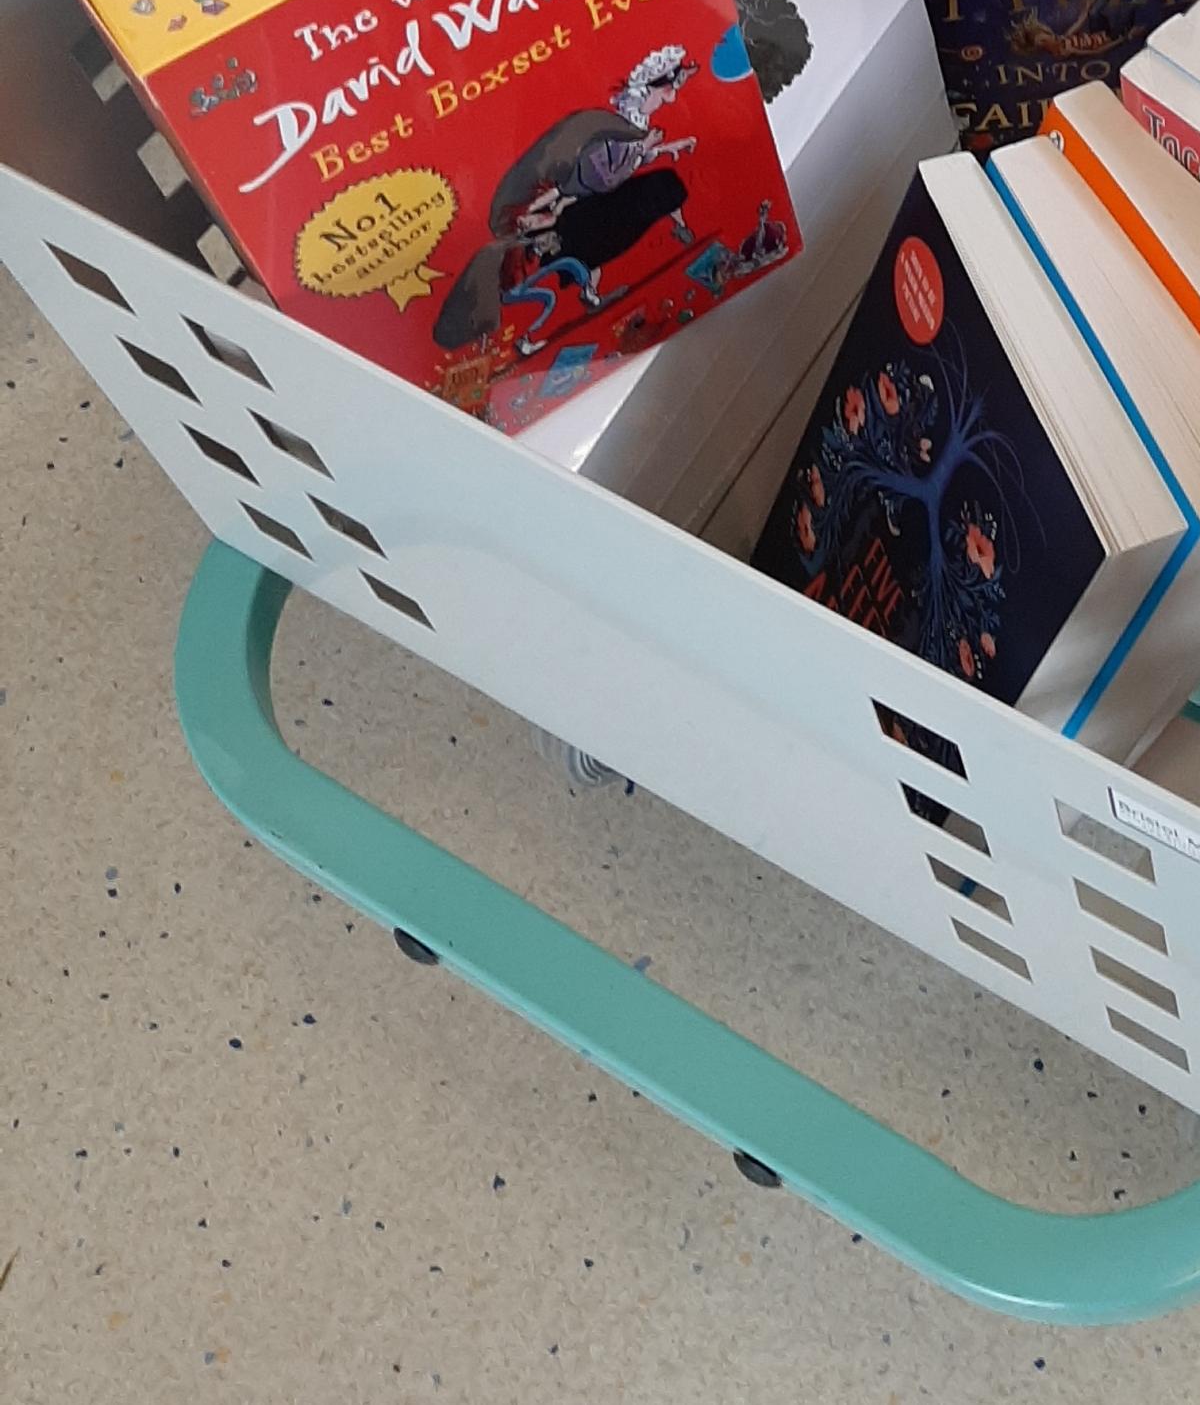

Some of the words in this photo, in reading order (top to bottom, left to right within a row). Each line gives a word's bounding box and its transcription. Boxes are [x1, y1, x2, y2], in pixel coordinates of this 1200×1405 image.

[294, 9, 379, 62] The
[309, 111, 415, 184] Best
[425, 23, 574, 120] Boxset
[996, 59, 1112, 87] INTO
[237, 19, 436, 194] David
[310, 189, 448, 285] bestselling
[319, 191, 405, 255] No.1
[353, 218, 435, 283] author
[1117, 799, 1179, 838] Bristol
